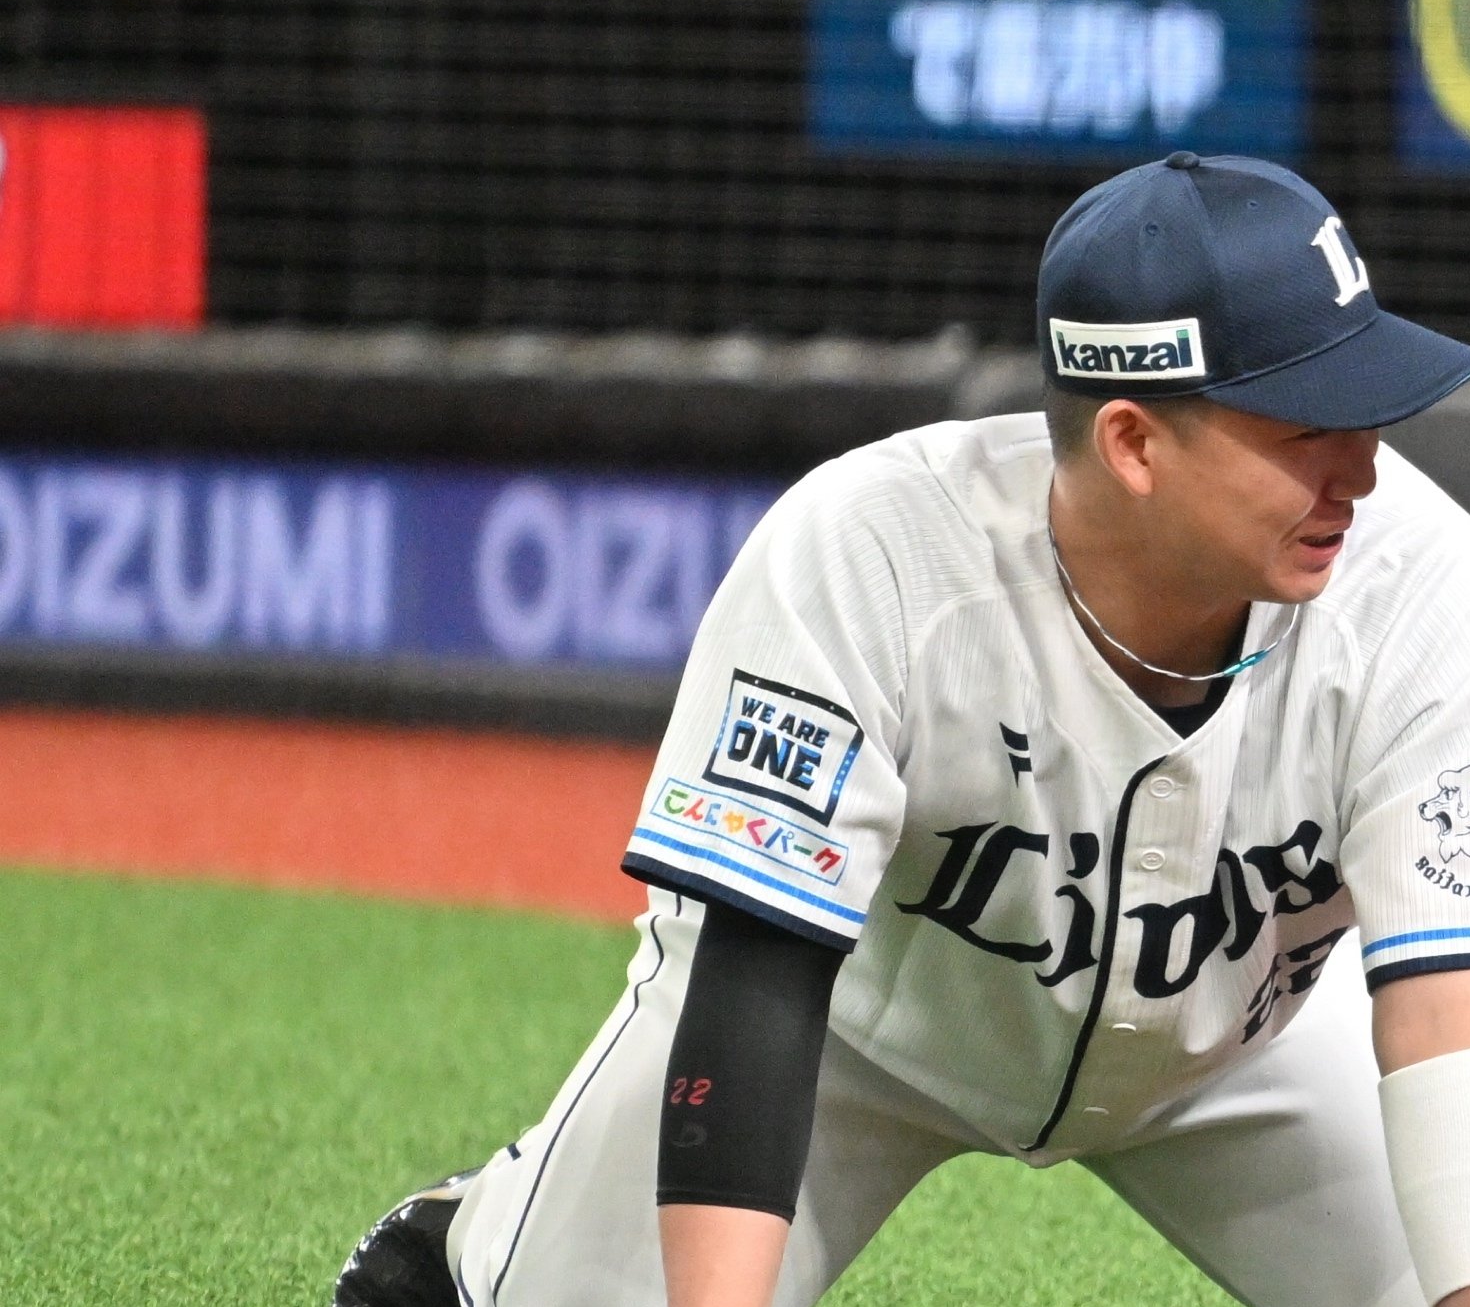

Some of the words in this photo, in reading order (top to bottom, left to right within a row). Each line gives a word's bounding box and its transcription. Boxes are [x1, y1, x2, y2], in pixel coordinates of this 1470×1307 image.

[1311, 215, 1370, 307] L
[1056, 328, 1193, 374] kanzai
[741, 695, 776, 724] WE
[777, 712, 830, 749] ARE
[727, 719, 822, 791] ONE
[664, 788, 842, 873] こんにゃくパーク
[670, 1077, 712, 1105] 22
